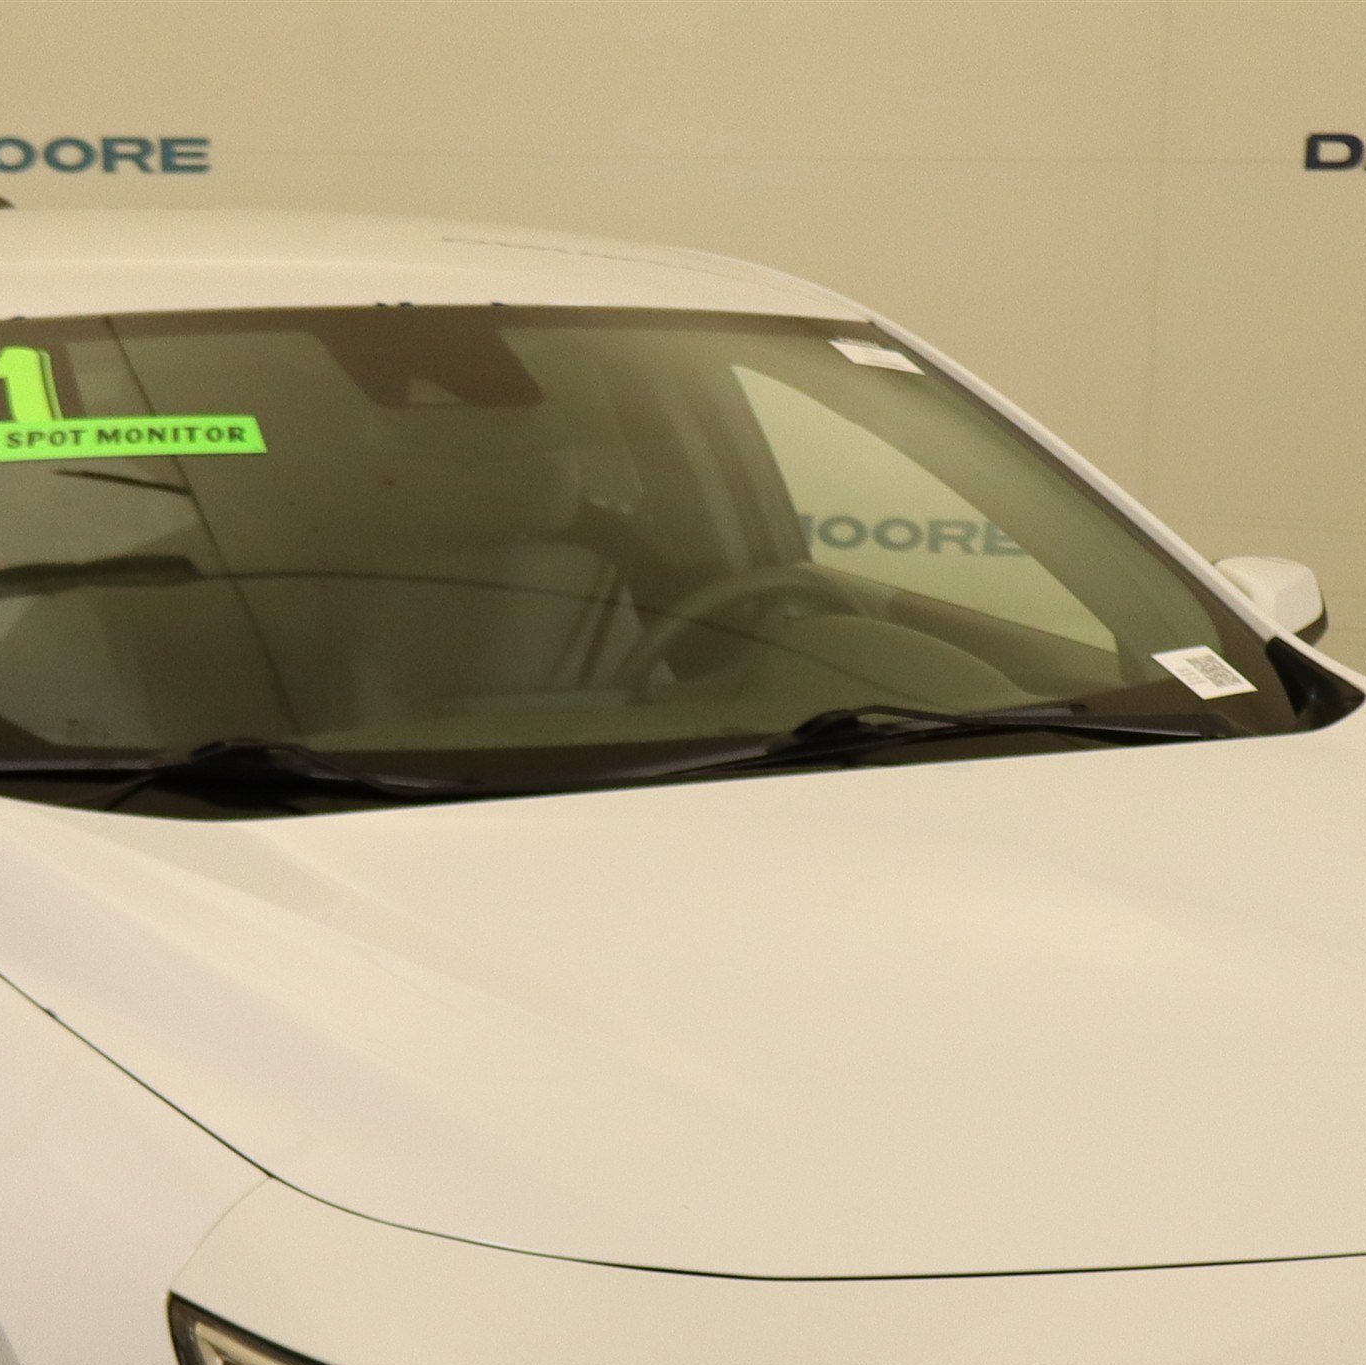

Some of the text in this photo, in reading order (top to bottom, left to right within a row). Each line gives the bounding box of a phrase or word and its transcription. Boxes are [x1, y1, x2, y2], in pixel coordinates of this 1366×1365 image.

[7, 430, 87, 449] SPOT
[96, 425, 248, 446] MONITOR
[798, 514, 1031, 558] OORE
